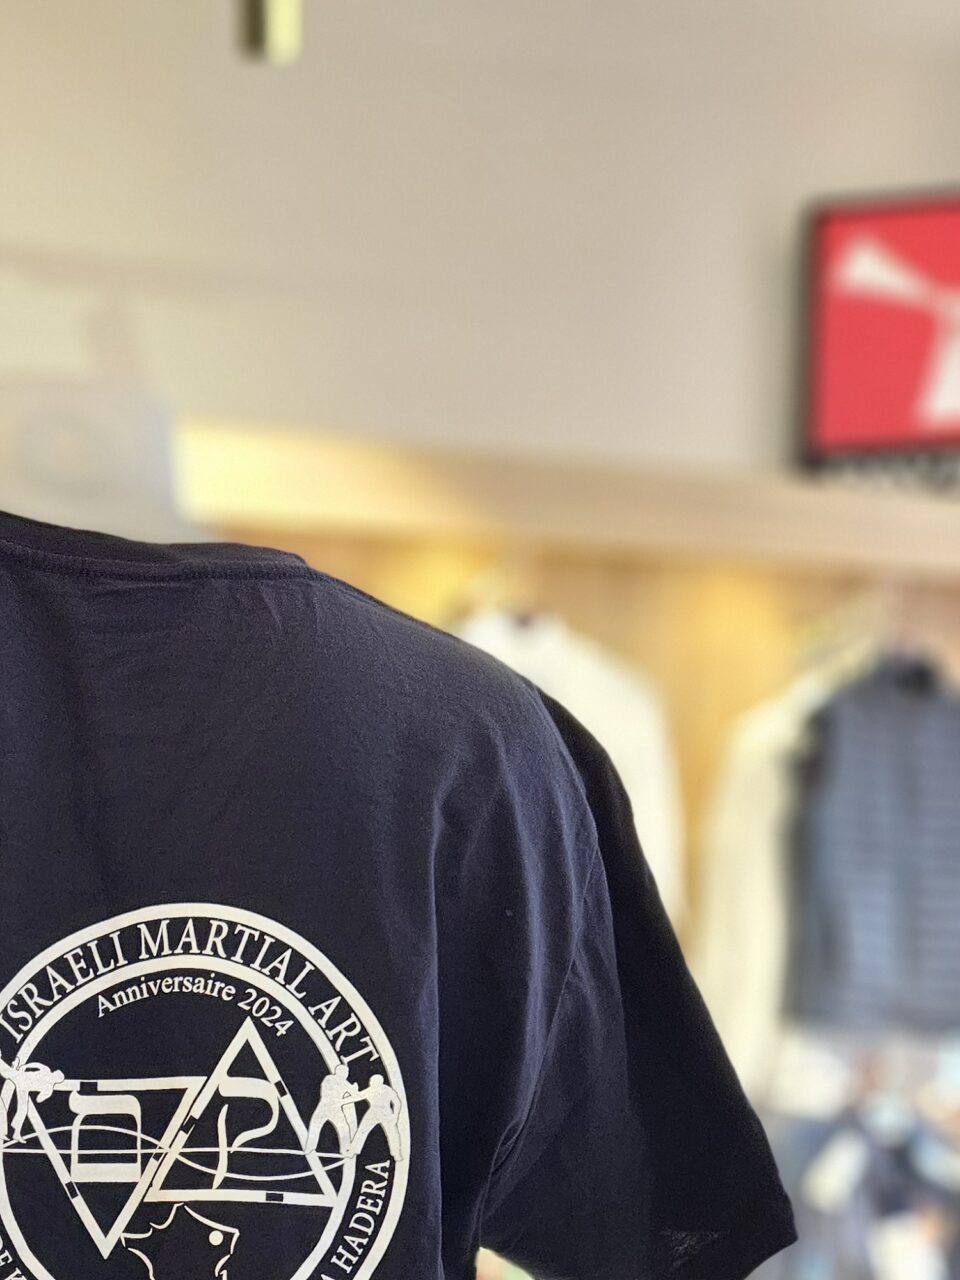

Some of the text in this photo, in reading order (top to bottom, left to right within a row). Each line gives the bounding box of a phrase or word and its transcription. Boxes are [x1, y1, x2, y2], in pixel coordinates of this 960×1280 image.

[99, 977, 294, 1036] Anniversaire 2024
[137, 918, 315, 998] MARTIAL
[308, 996, 379, 1064] ART
[331, 1160, 390, 1273] HADERA
